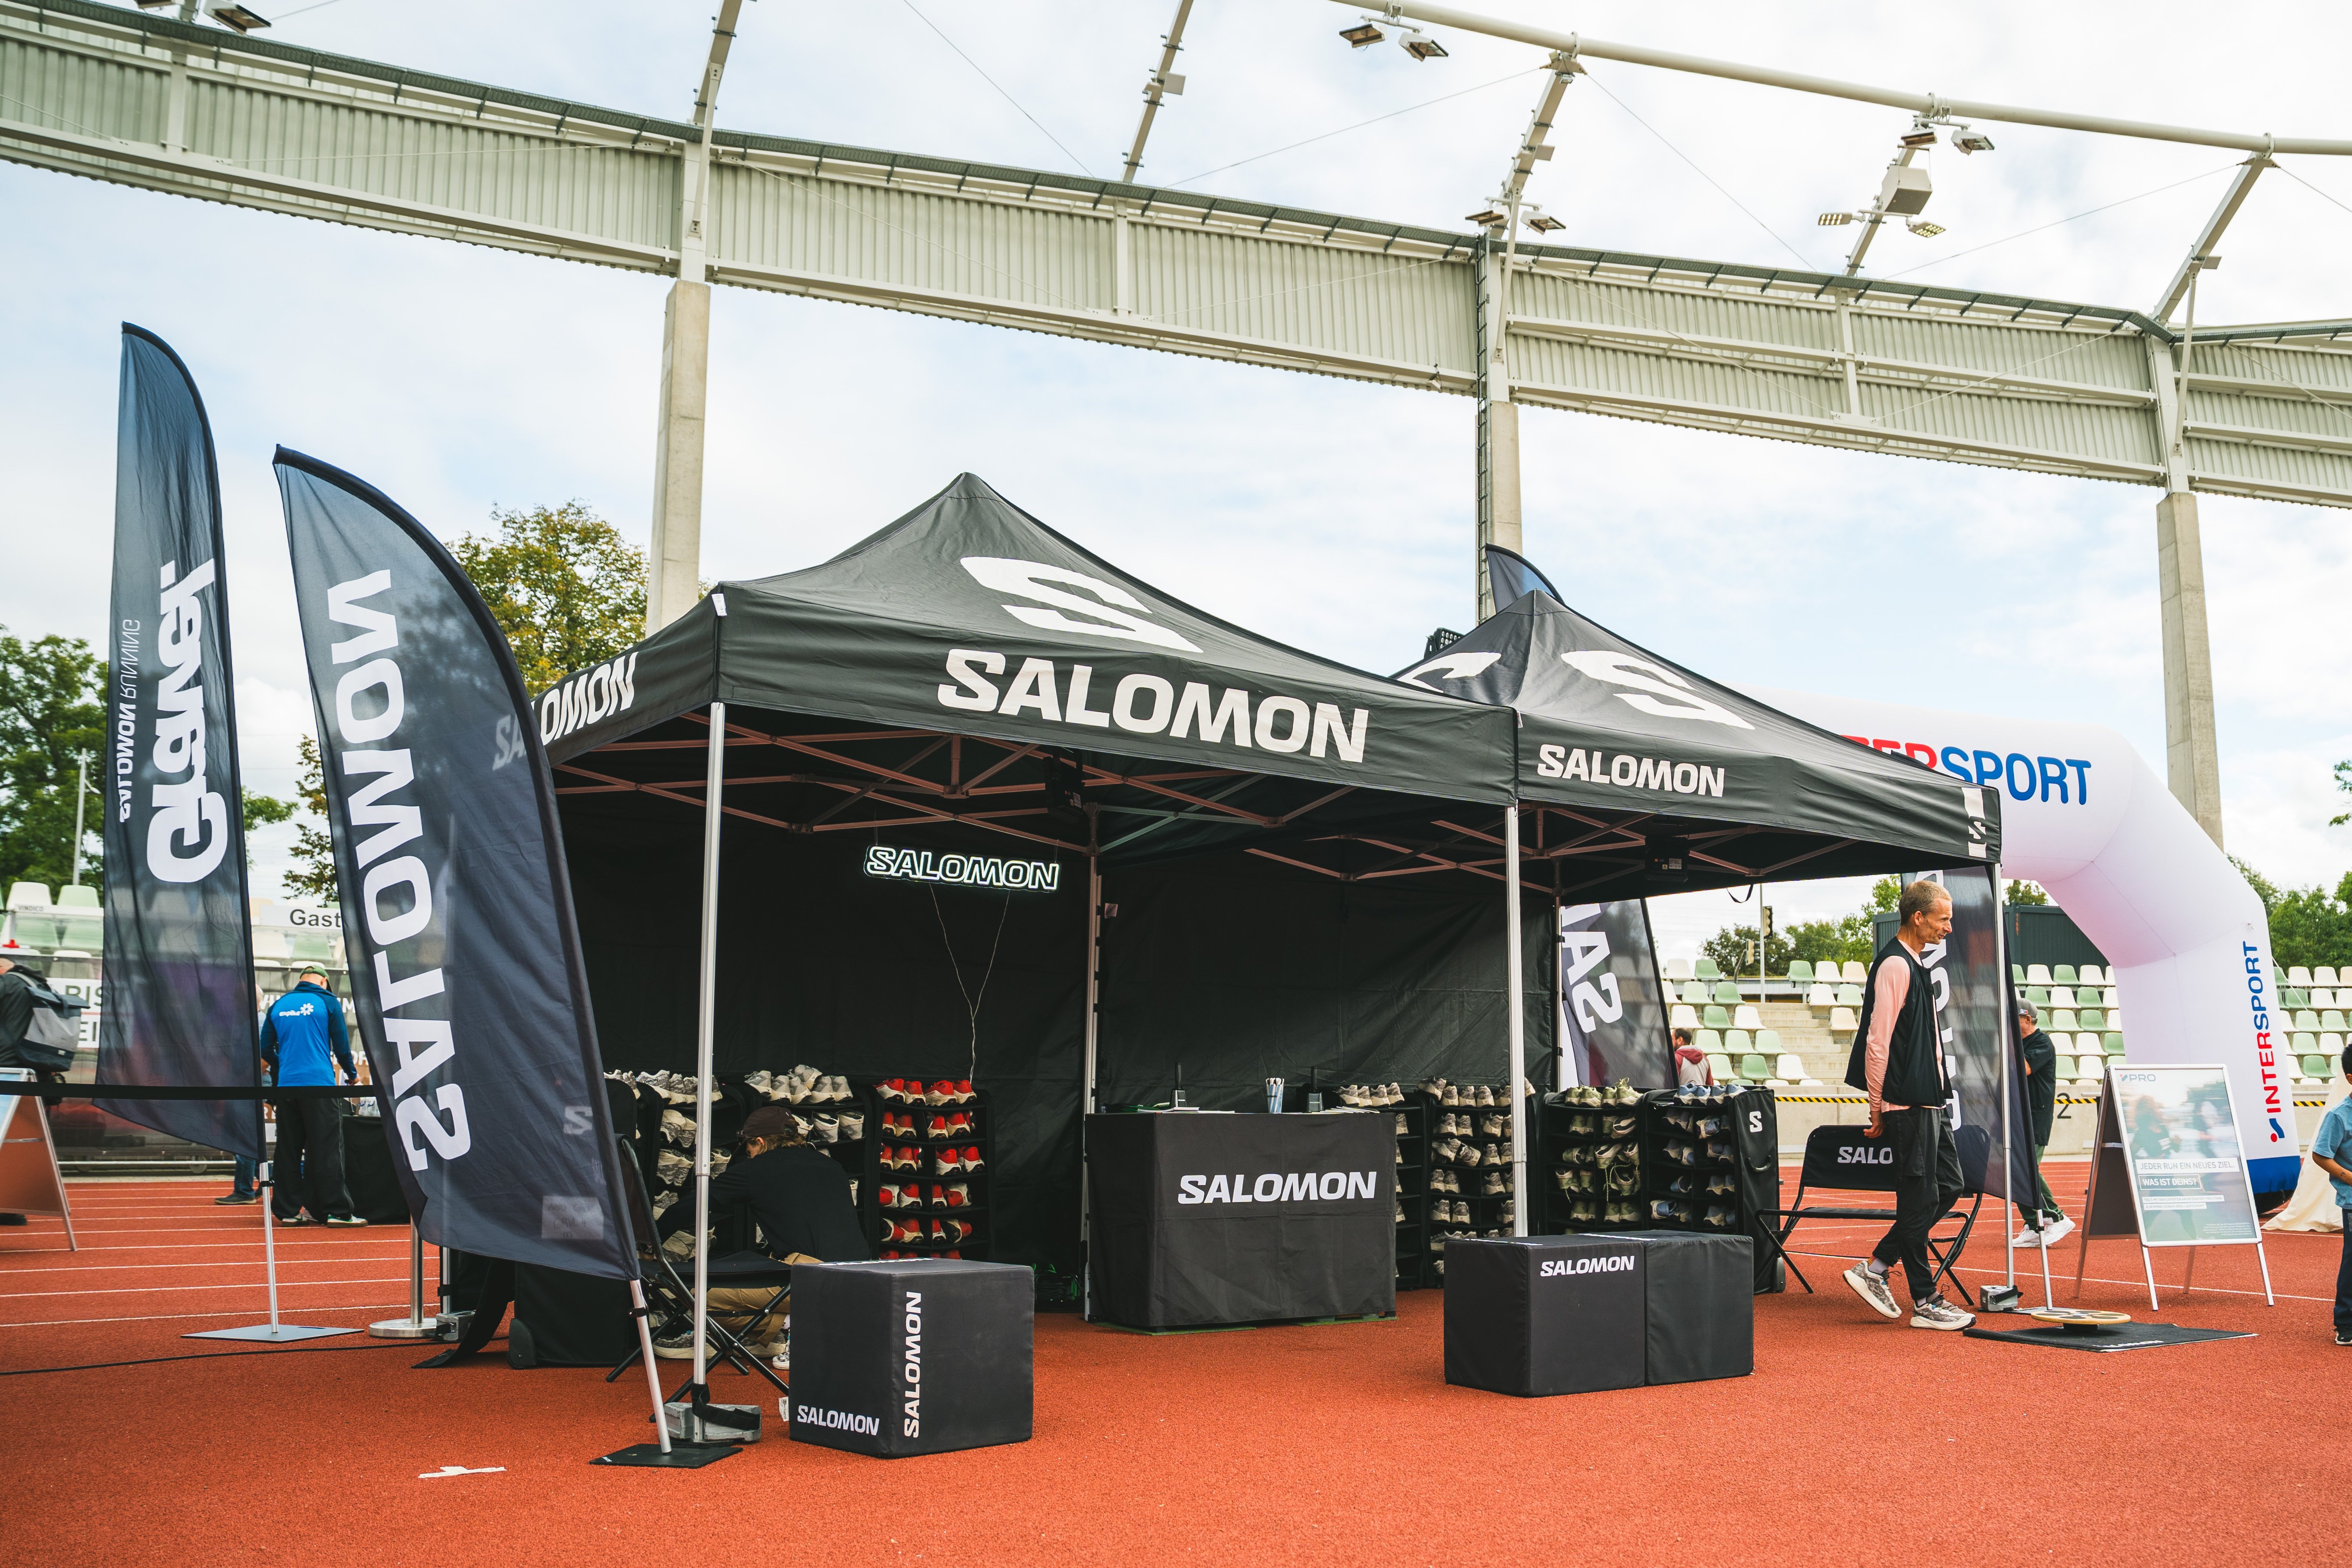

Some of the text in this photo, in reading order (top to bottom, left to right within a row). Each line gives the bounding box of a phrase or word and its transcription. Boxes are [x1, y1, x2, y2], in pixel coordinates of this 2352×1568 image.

[492, 652, 638, 771] SAOMON
[938, 649, 1369, 763] SALOMON
[1537, 744, 1725, 797] SALOMON
[869, 846, 1059, 890] SALOMON
[2243, 941, 2281, 1113] INTERSPORT
[2057, 1093, 2071, 1119] 2
[1838, 1146, 1893, 1164] SALO
[1178, 1172, 1377, 1204] SALOMON
[1540, 1255, 1634, 1277] SALOMON
[904, 1291, 921, 1438] SALOMON
[797, 1405, 879, 1436] SALOMON
